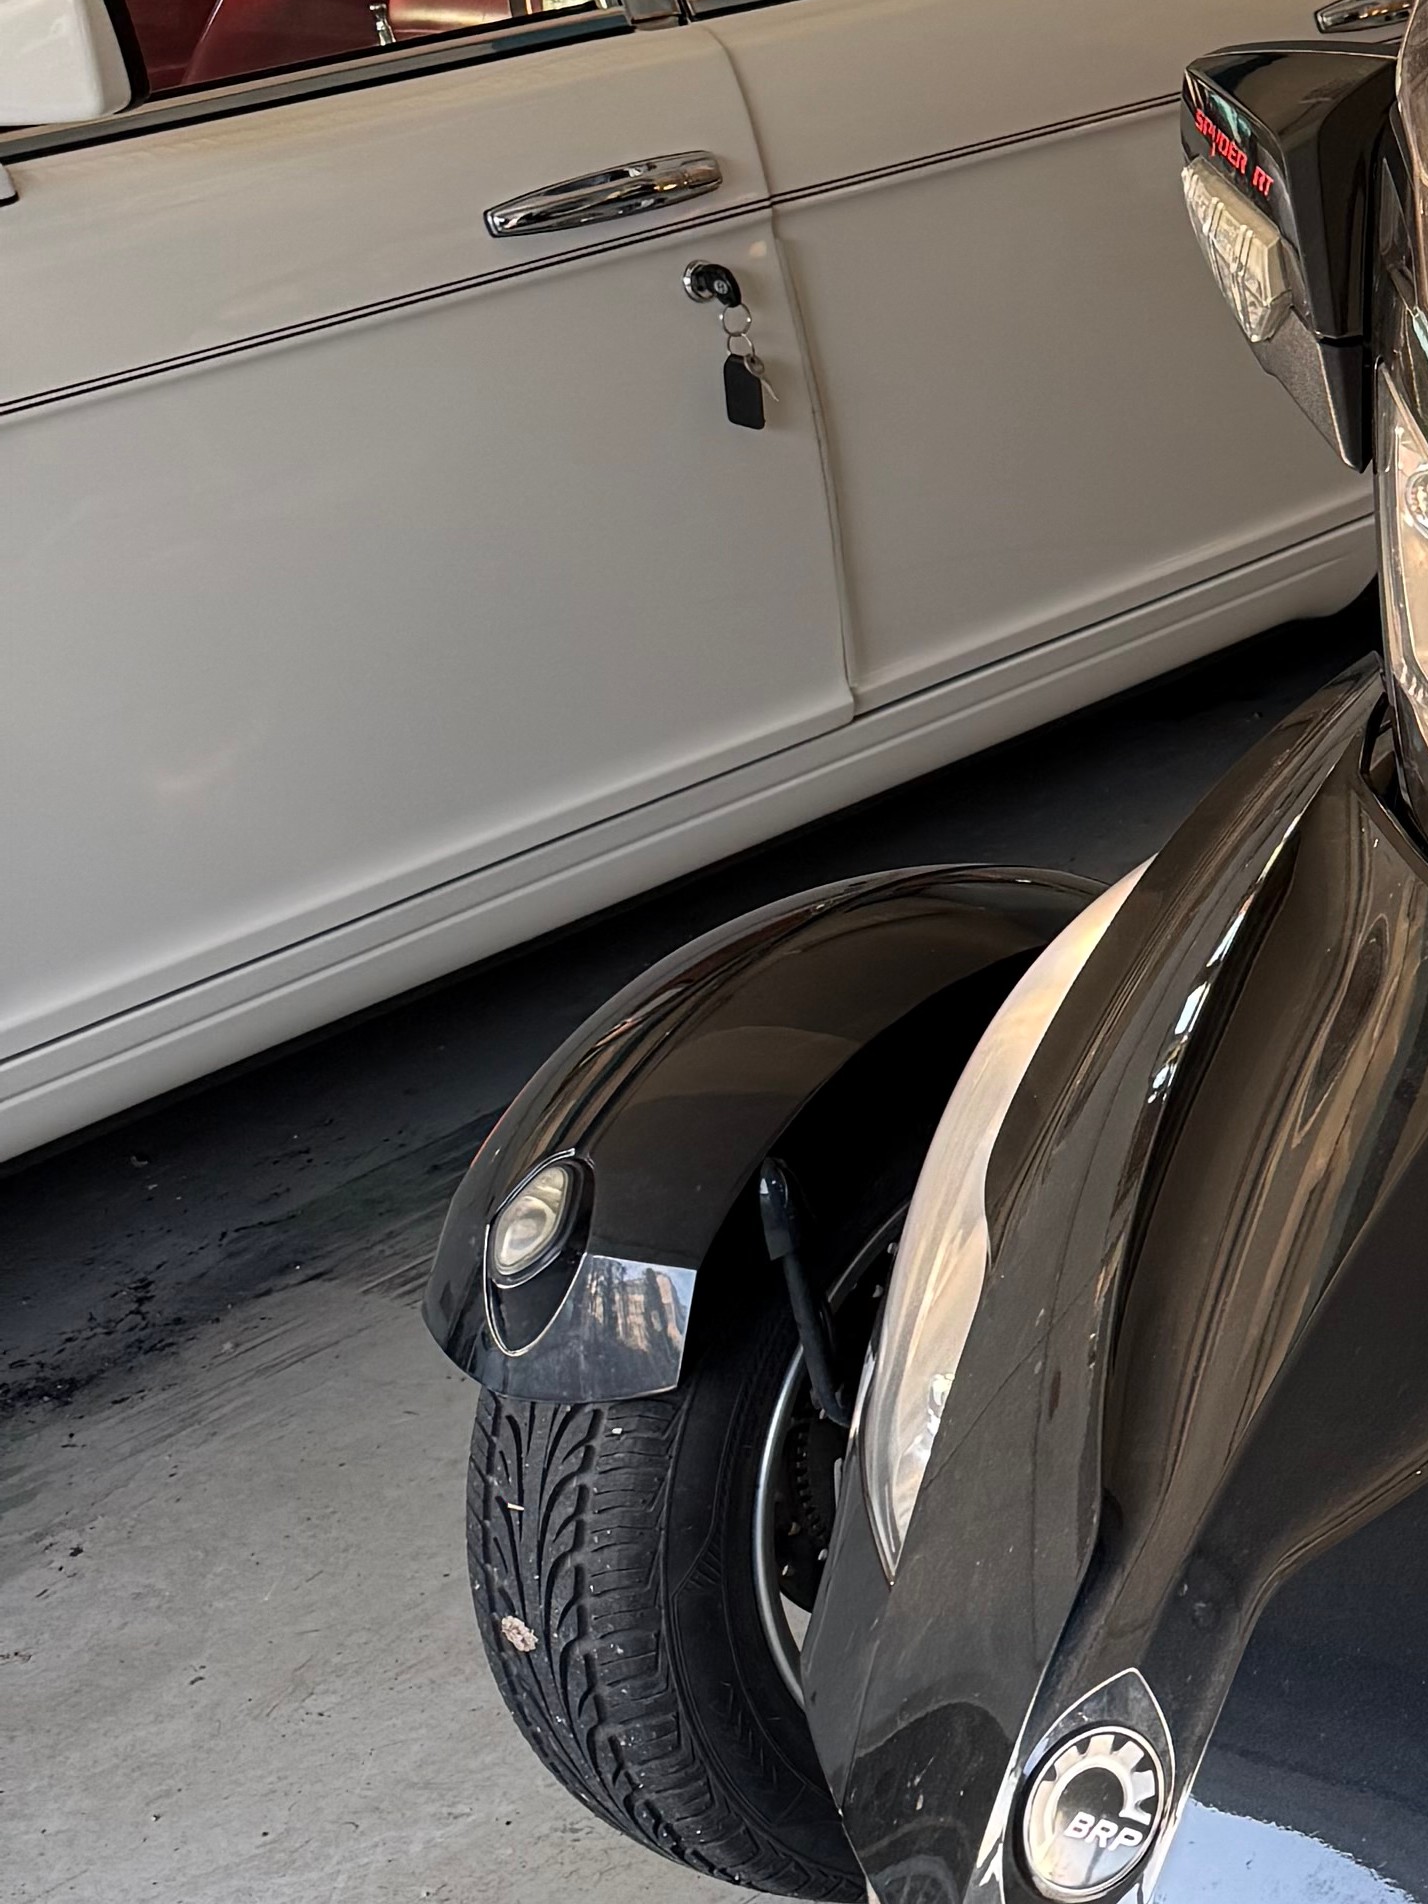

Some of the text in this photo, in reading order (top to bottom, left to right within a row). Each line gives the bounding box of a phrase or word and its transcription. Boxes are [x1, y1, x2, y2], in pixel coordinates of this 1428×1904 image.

[1194, 107, 1275, 197] SPYDER RT
[1063, 1811, 1144, 1852] BRP
